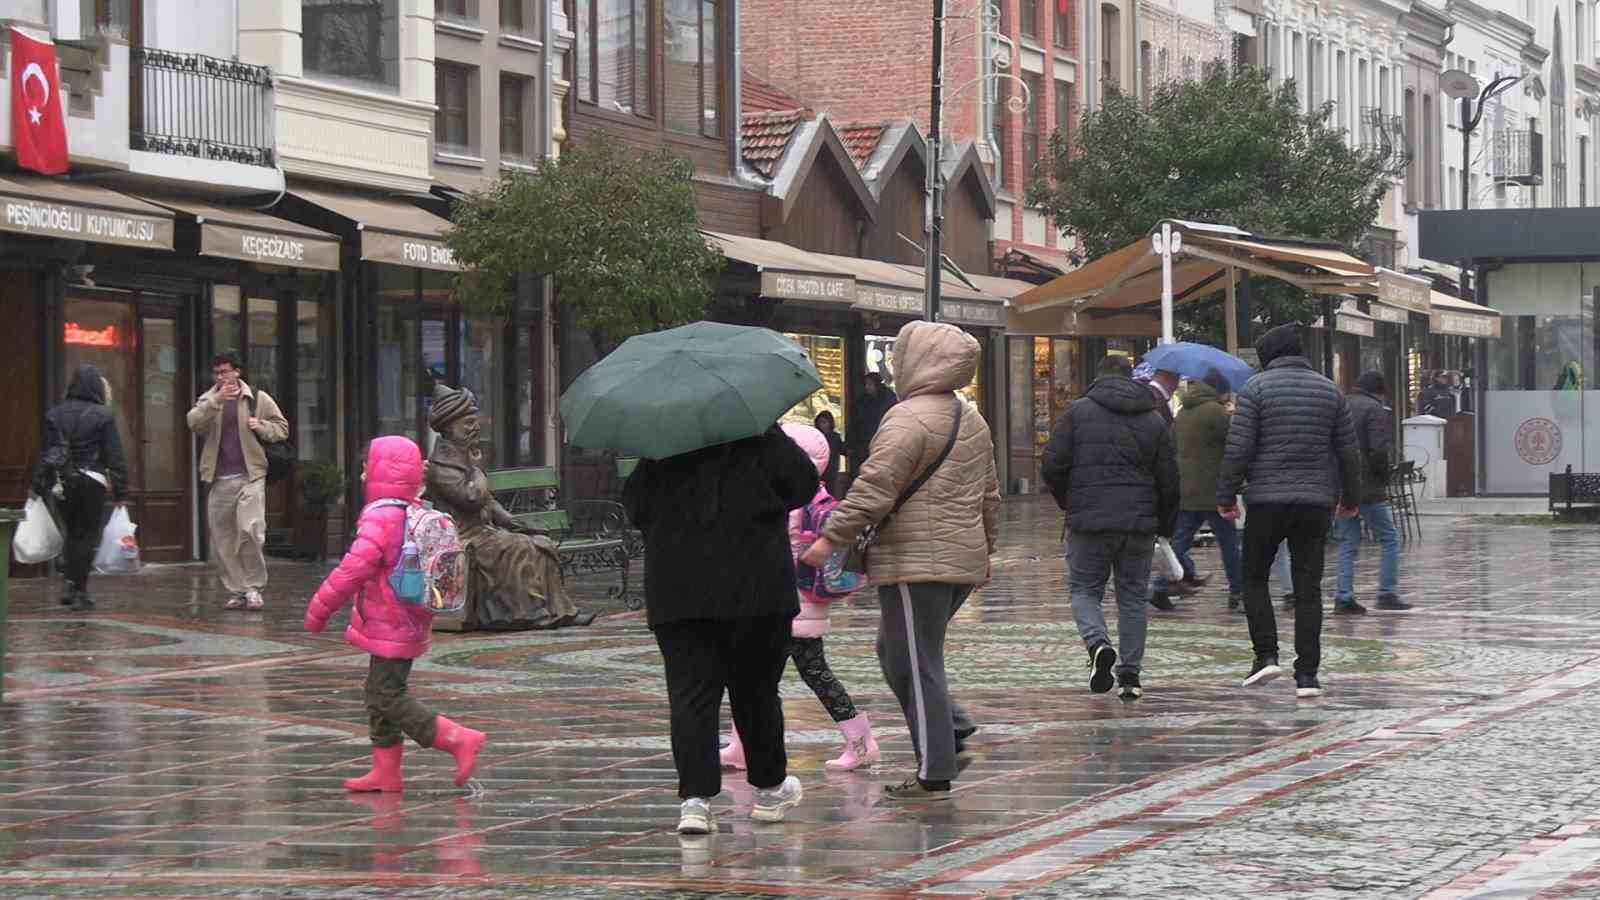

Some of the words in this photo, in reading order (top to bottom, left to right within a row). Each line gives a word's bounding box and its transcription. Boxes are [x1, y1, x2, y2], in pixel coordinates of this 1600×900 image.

[7, 202, 82, 232] PEŞİNCİOĞLU
[87, 214, 154, 241] KUYUMCUSU
[242, 235, 304, 261] KEÇECİZADE
[403, 242, 428, 262] FOTO
[431, 246, 459, 265] ENDE
